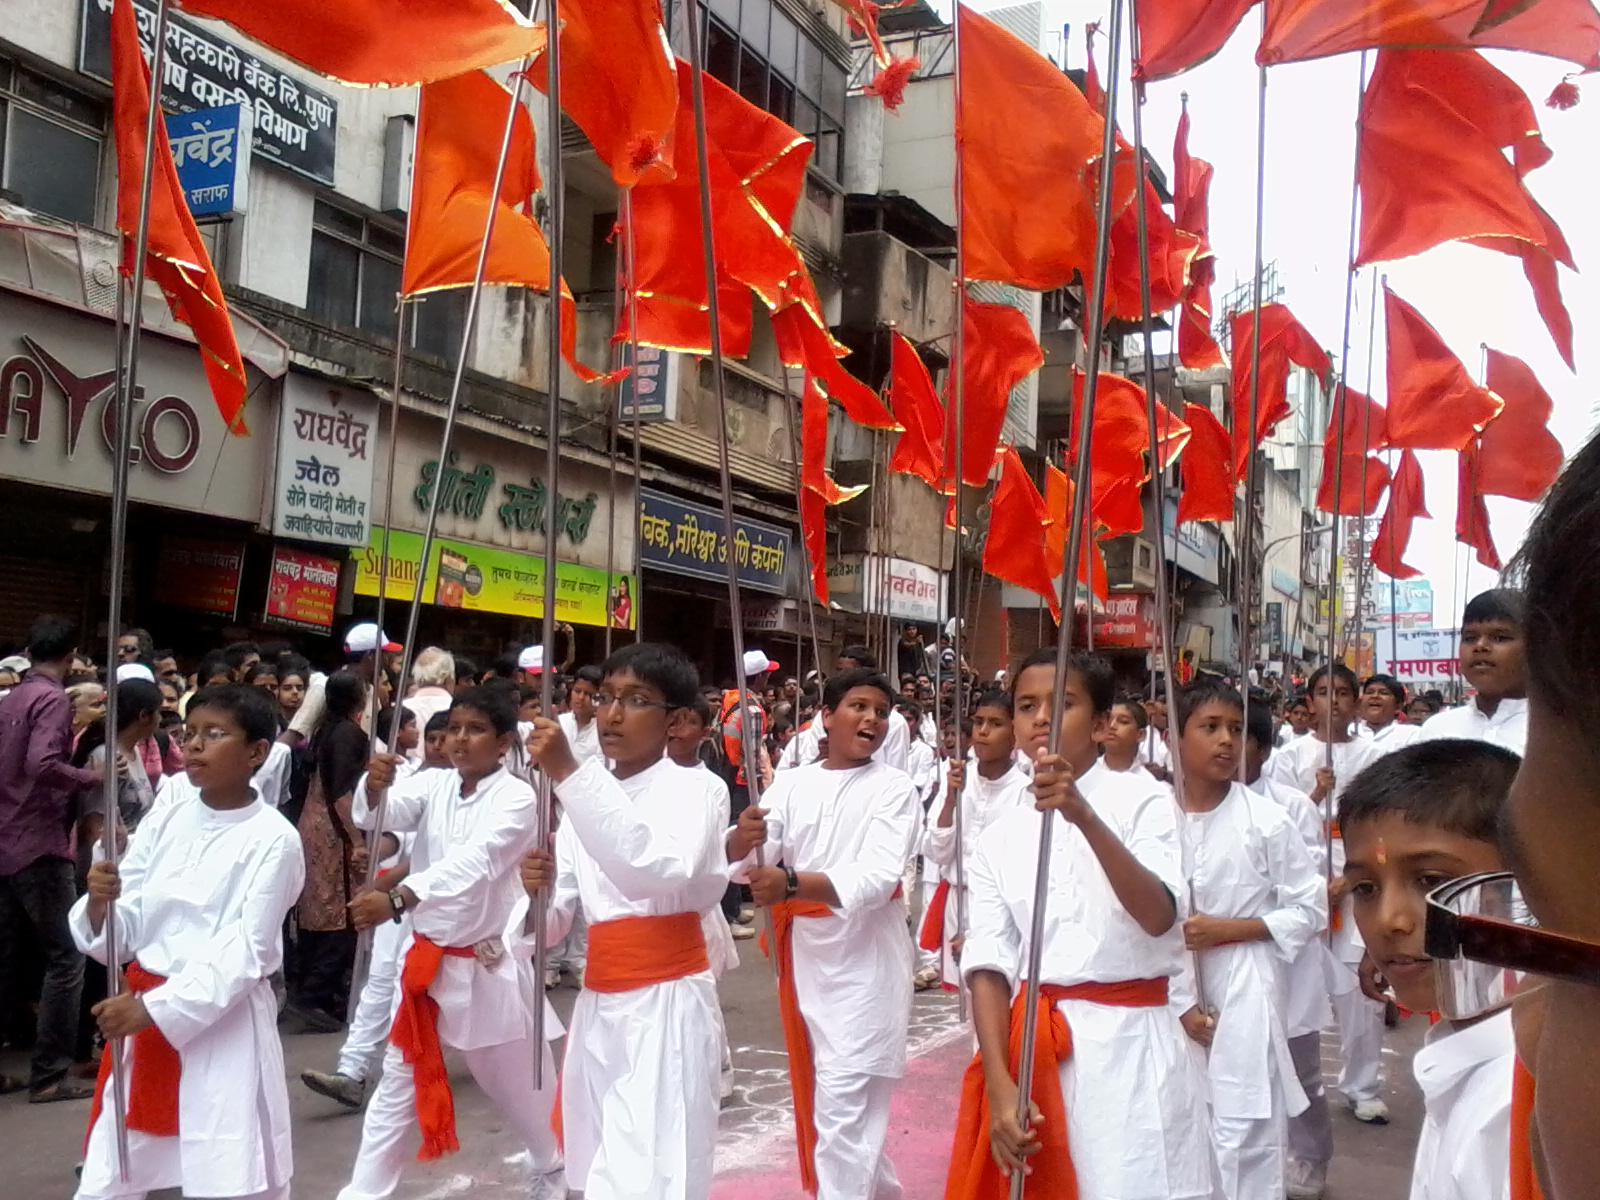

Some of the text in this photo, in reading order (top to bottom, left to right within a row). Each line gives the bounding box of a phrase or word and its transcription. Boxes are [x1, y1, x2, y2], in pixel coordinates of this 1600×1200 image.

[165, 20, 241, 80] सहकारी
[254, 97, 309, 151] विभाग
[293, 408, 370, 461] राघवेंद्र
[751, 534, 785, 575] कंपनी
